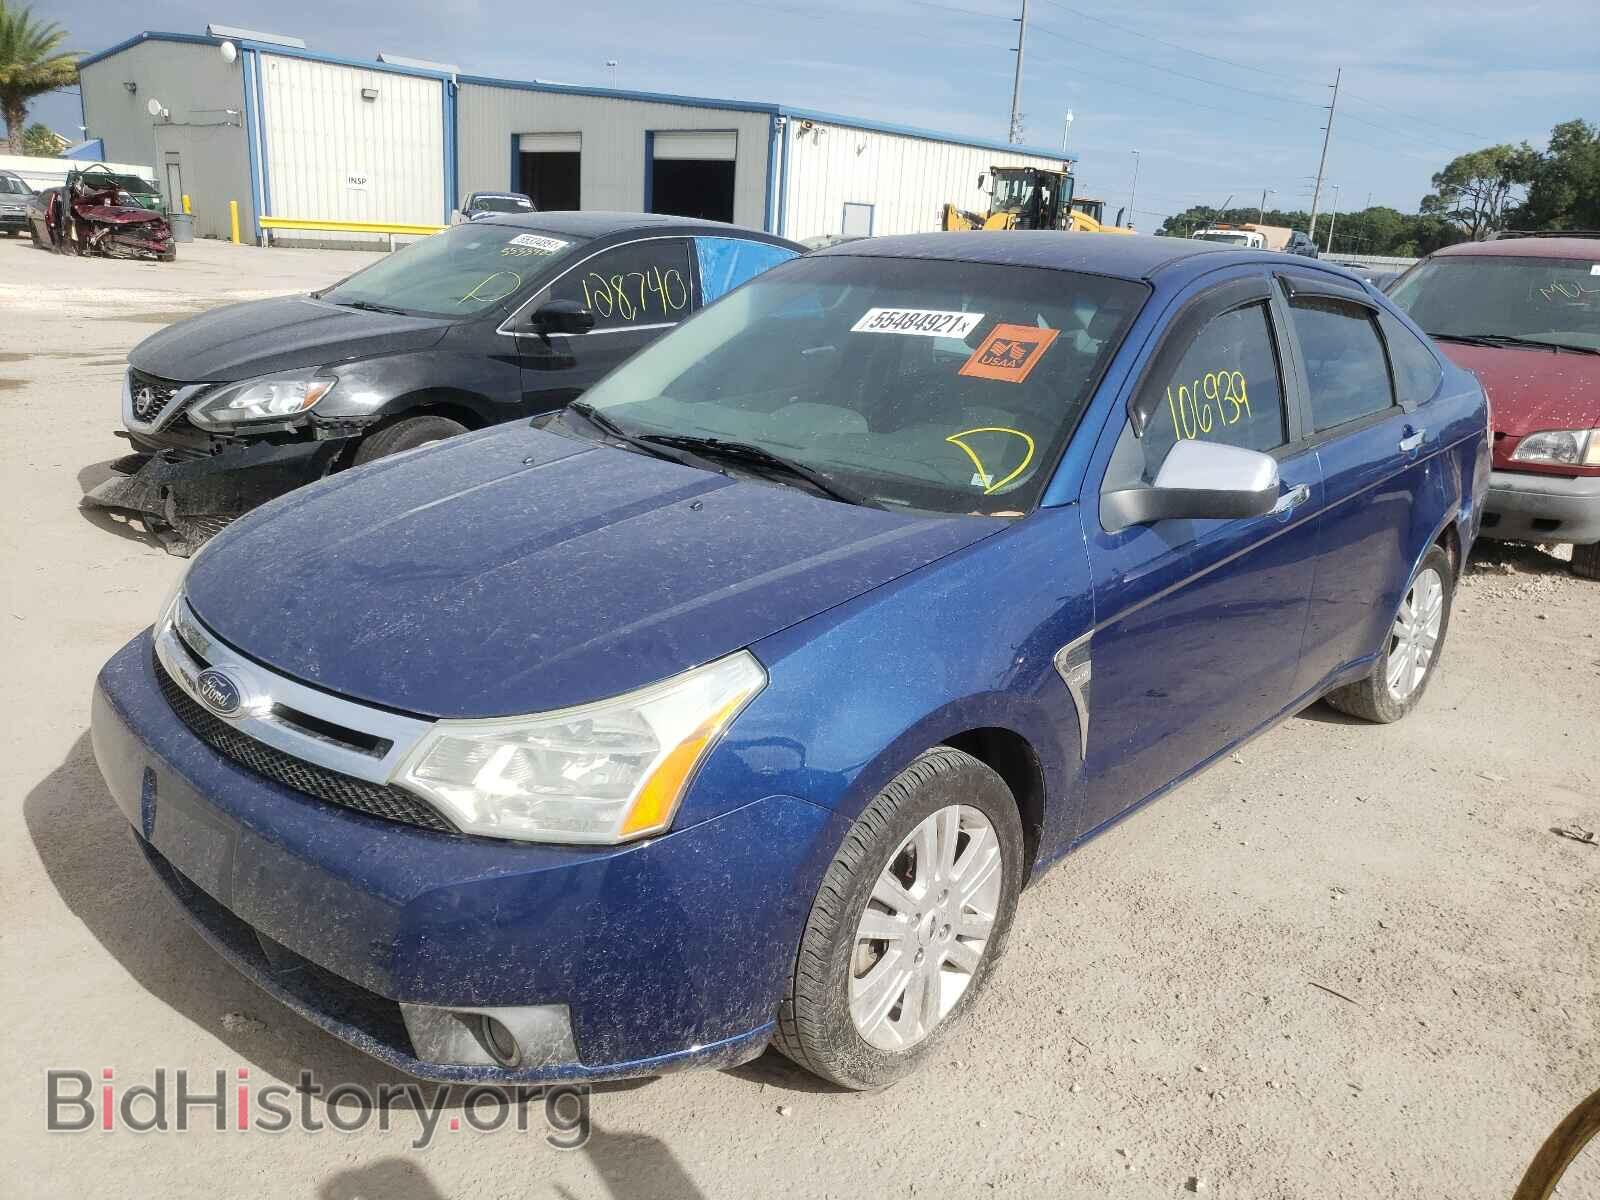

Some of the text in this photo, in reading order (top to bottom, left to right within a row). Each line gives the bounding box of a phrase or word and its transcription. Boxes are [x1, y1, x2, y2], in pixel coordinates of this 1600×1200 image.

[348, 176, 368, 185] INSP
[582, 265, 687, 321] 128,740
[981, 355, 1018, 368] USAA
[1167, 370, 1252, 440] 106939
[202, 676, 232, 706] Ford
